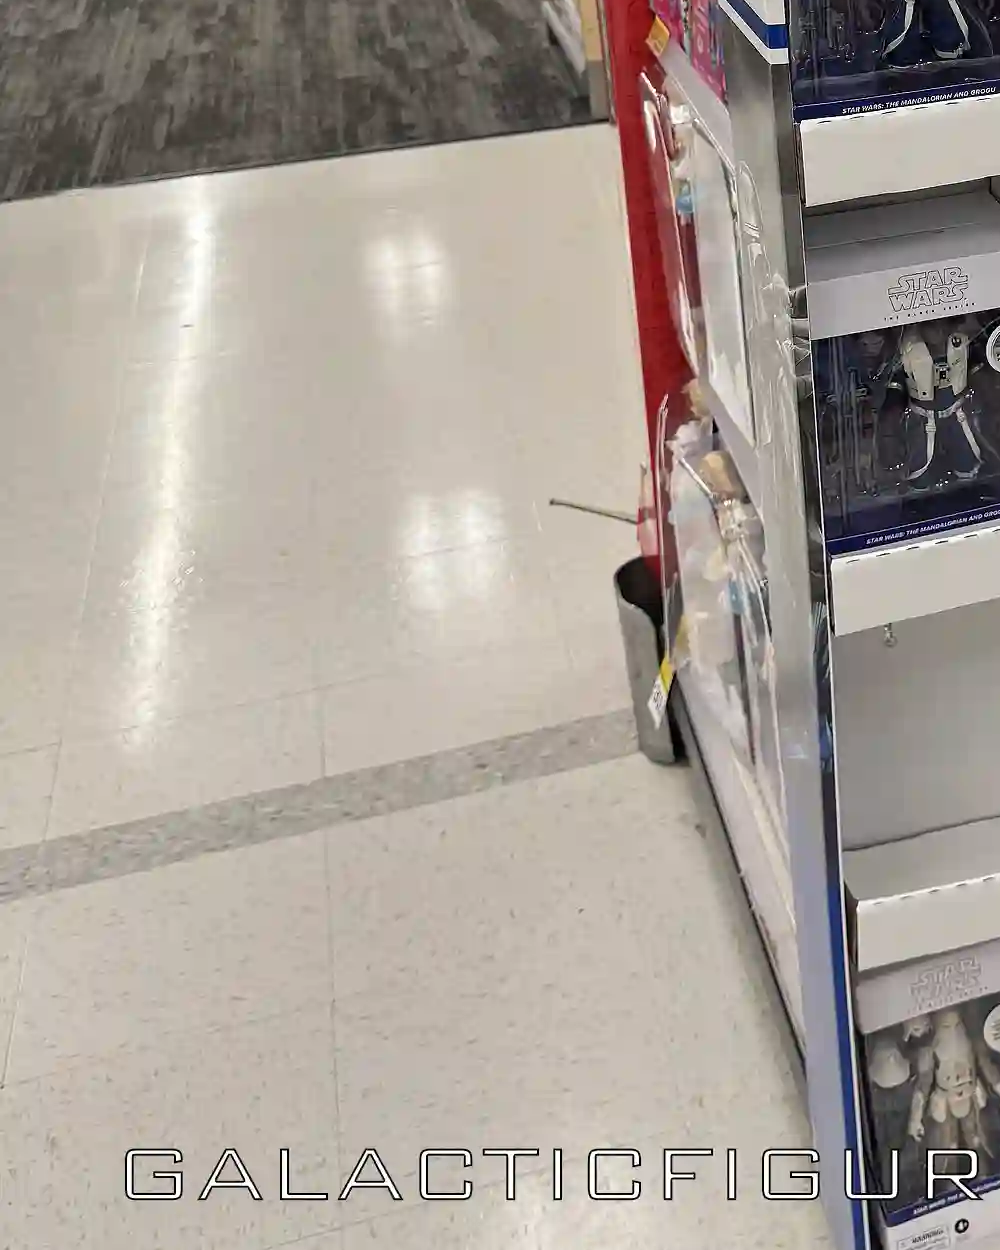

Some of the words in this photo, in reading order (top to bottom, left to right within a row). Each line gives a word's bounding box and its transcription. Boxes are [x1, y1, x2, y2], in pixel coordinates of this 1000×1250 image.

[885, 101, 899, 109] THE
[900, 93, 953, 106] MANDALORIAN
[954, 90, 969, 98] AND
[970, 87, 997, 96] GROGU
[888, 266, 968, 295] STAR
[888, 283, 969, 312] WARS
[920, 518, 968, 532] MANDALORIAN
[969, 514, 983, 522] AND
